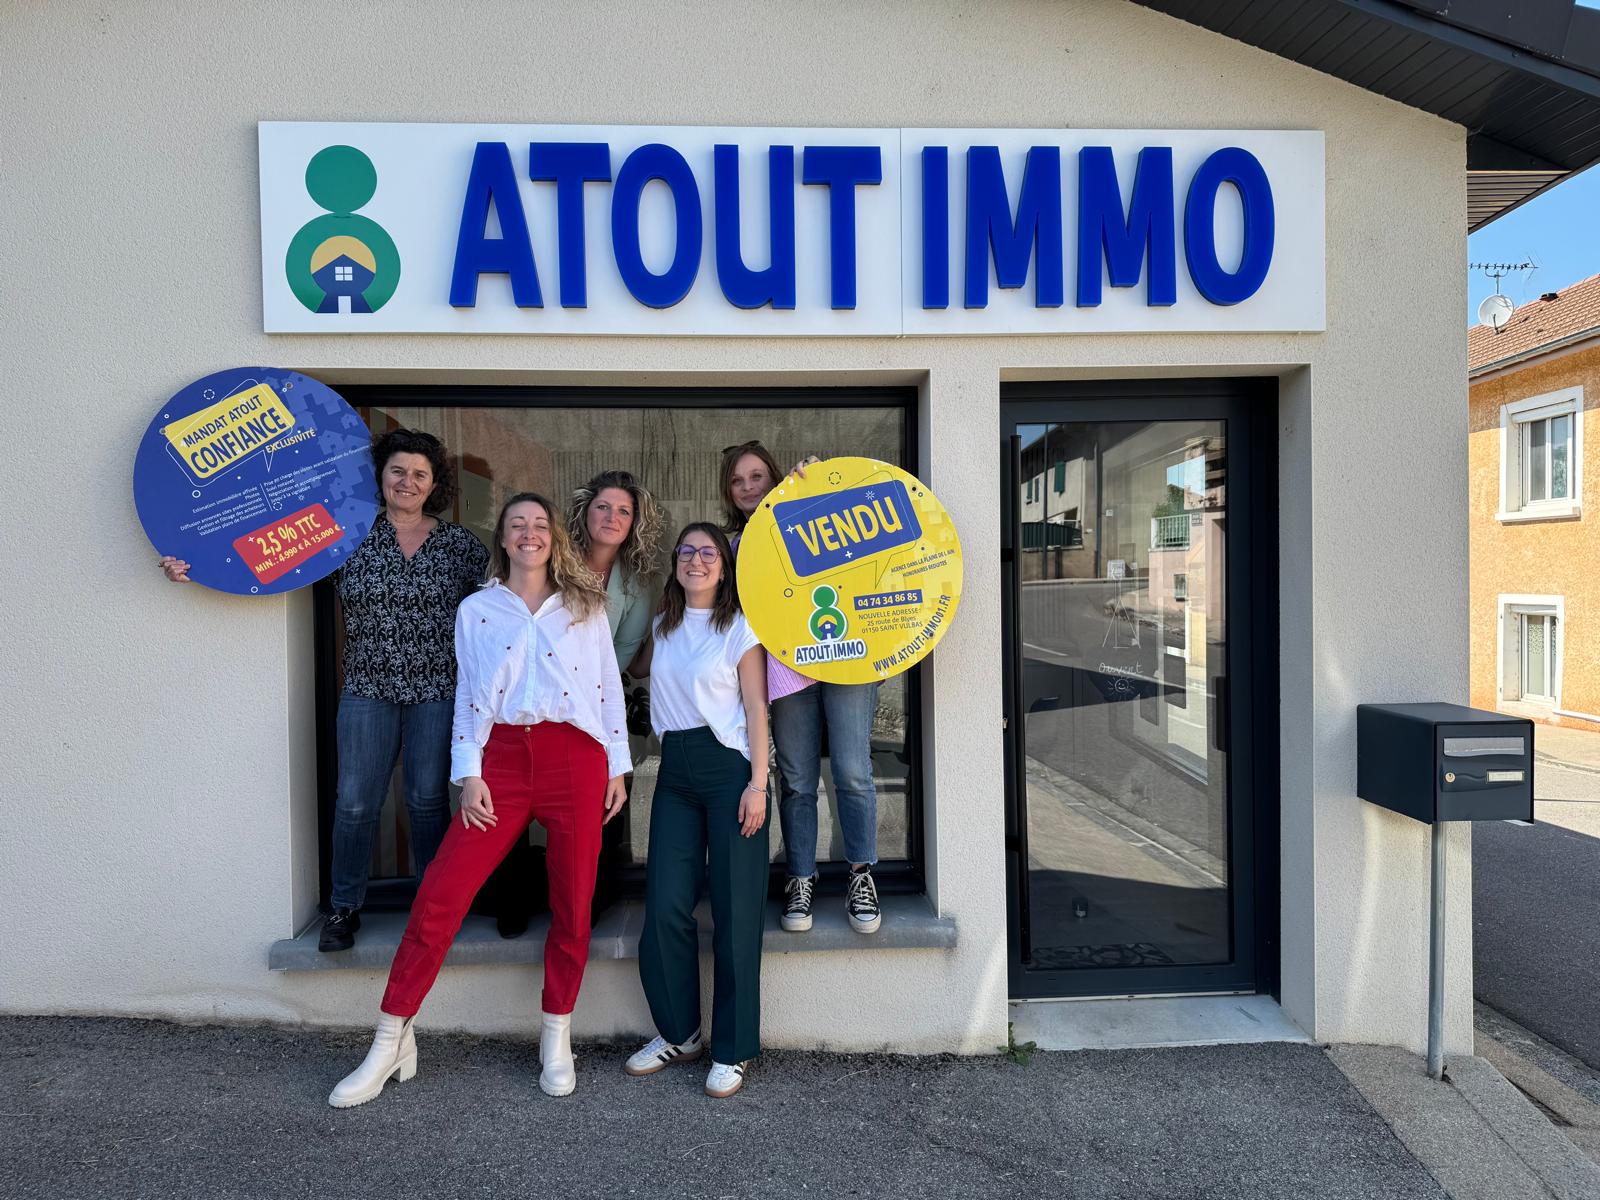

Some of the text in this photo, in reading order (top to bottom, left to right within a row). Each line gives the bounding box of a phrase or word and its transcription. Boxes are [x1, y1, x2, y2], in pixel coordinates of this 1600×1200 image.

[449, 142, 1275, 310] ATOUT IMMO
[182, 395, 262, 448] MANDAT ATOUT
[191, 408, 286, 473] CONFIANCE
[265, 429, 316, 453] EXCLUSIVITÉ
[257, 514, 321, 555] 2,5 % TTC
[311, 528, 334, 544] 15.000
[794, 496, 903, 556] VENDU
[859, 611, 890, 620] NOUVELLE
[870, 597, 880, 606] 74
[882, 596, 893, 604] 34
[895, 594, 905, 602] 86
[907, 593, 917, 601] 85
[796, 642, 864, 662] ATOUT IMMO
